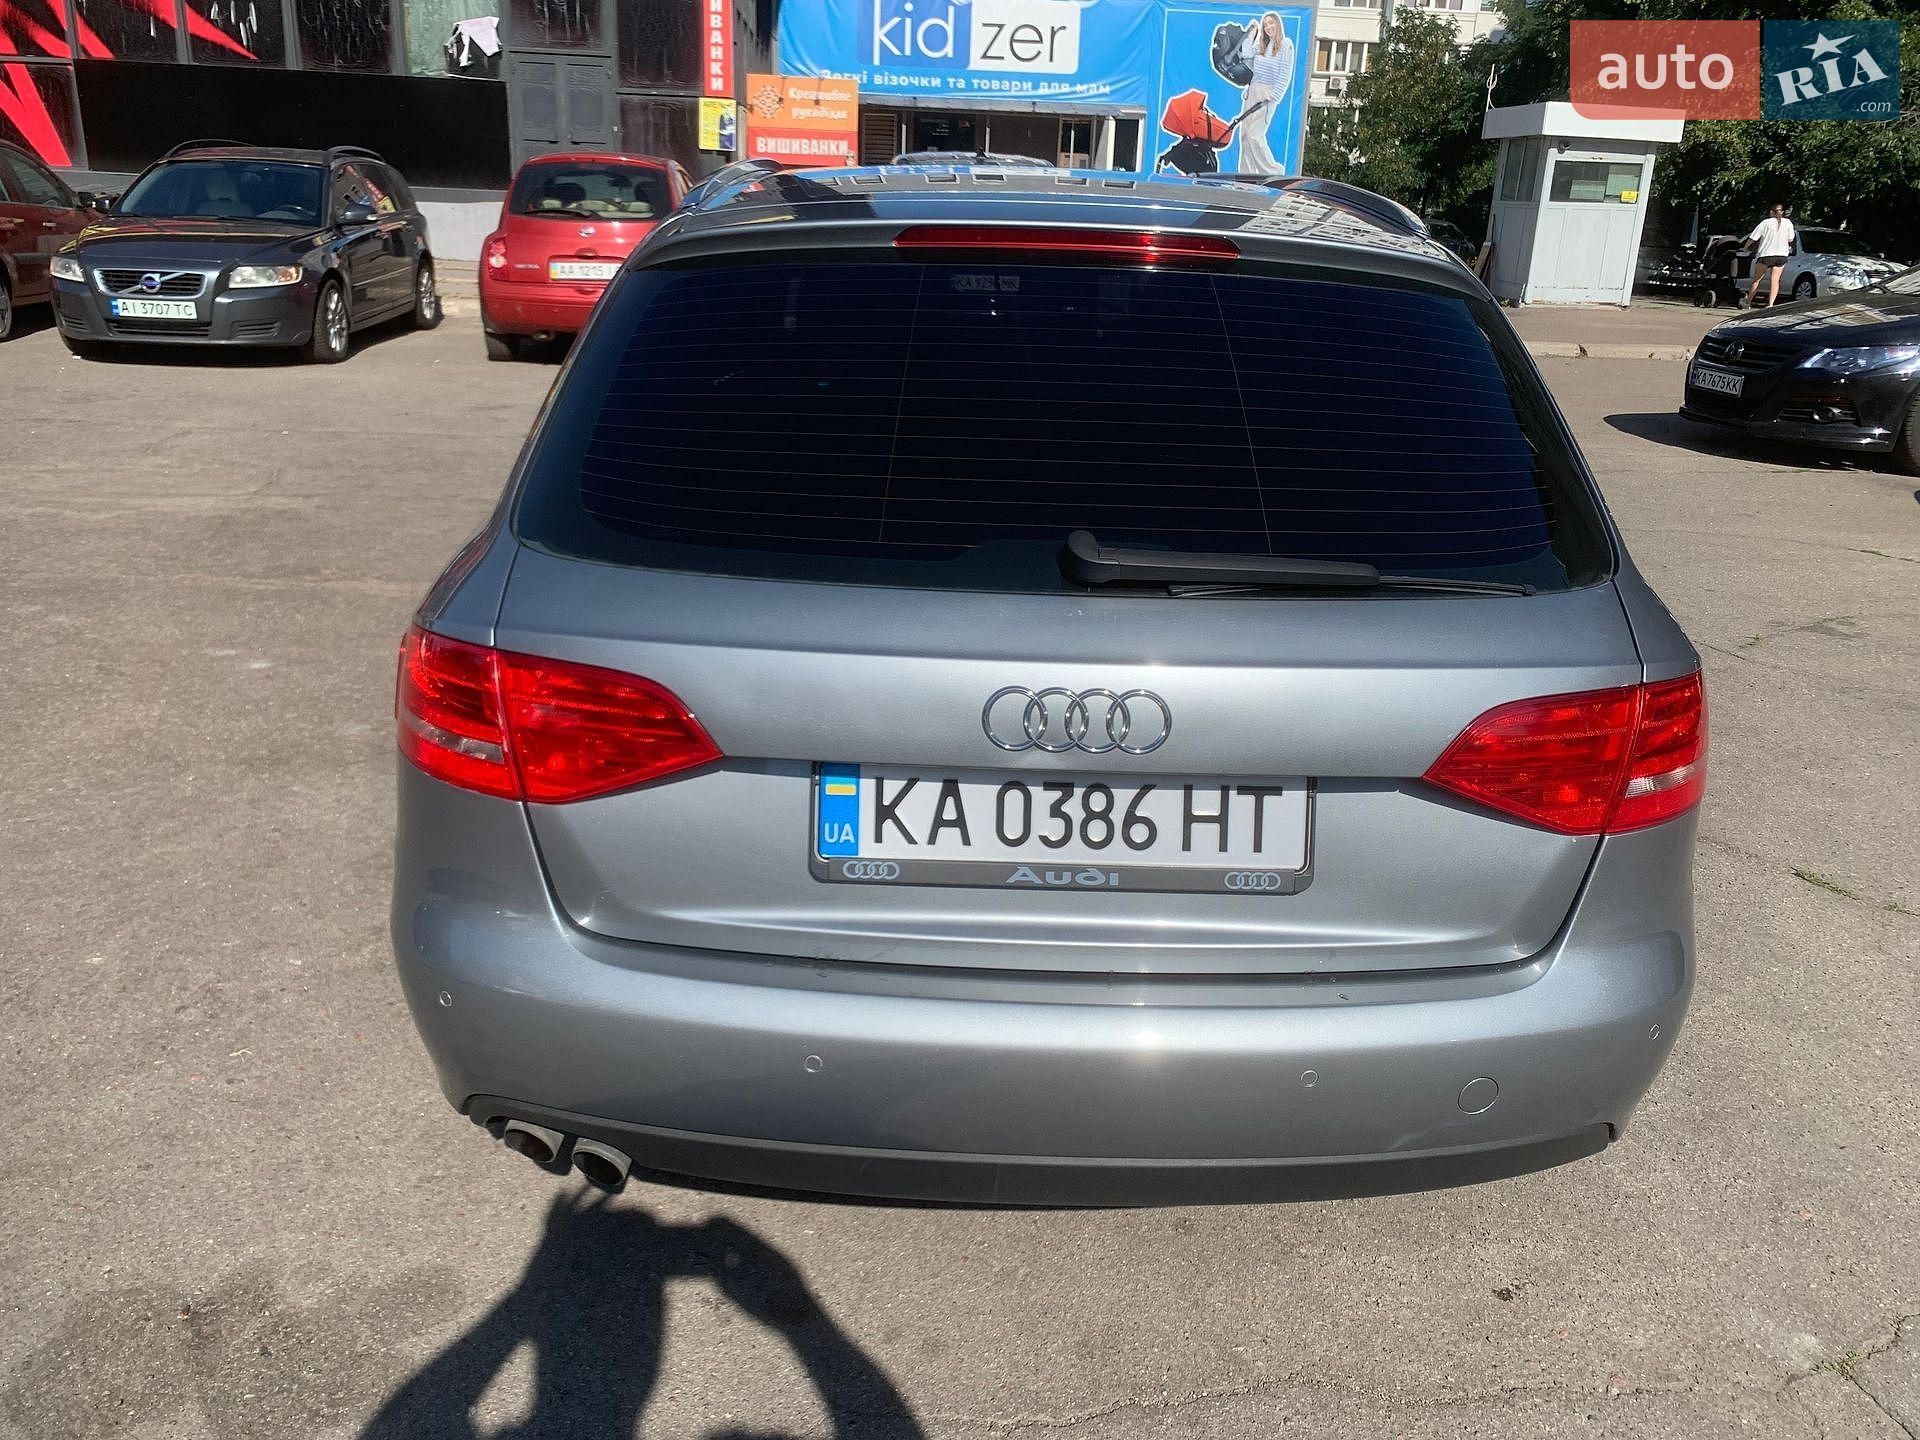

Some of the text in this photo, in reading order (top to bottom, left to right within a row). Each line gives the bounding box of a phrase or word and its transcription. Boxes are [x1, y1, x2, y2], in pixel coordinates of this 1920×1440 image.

[873, 0, 1066, 66] kid zer
[874, 72, 942, 88] візочки
[947, 77, 966, 89] та
[972, 78, 1033, 93] товари
[756, 137, 849, 156] ВИШИВАНКИ
[140, 302, 170, 316] 3707
[174, 304, 193, 317] TC
[874, 777, 1284, 854] KA 0386 HT
[823, 822, 855, 844] UA
[1005, 866, 1120, 887] Audi
